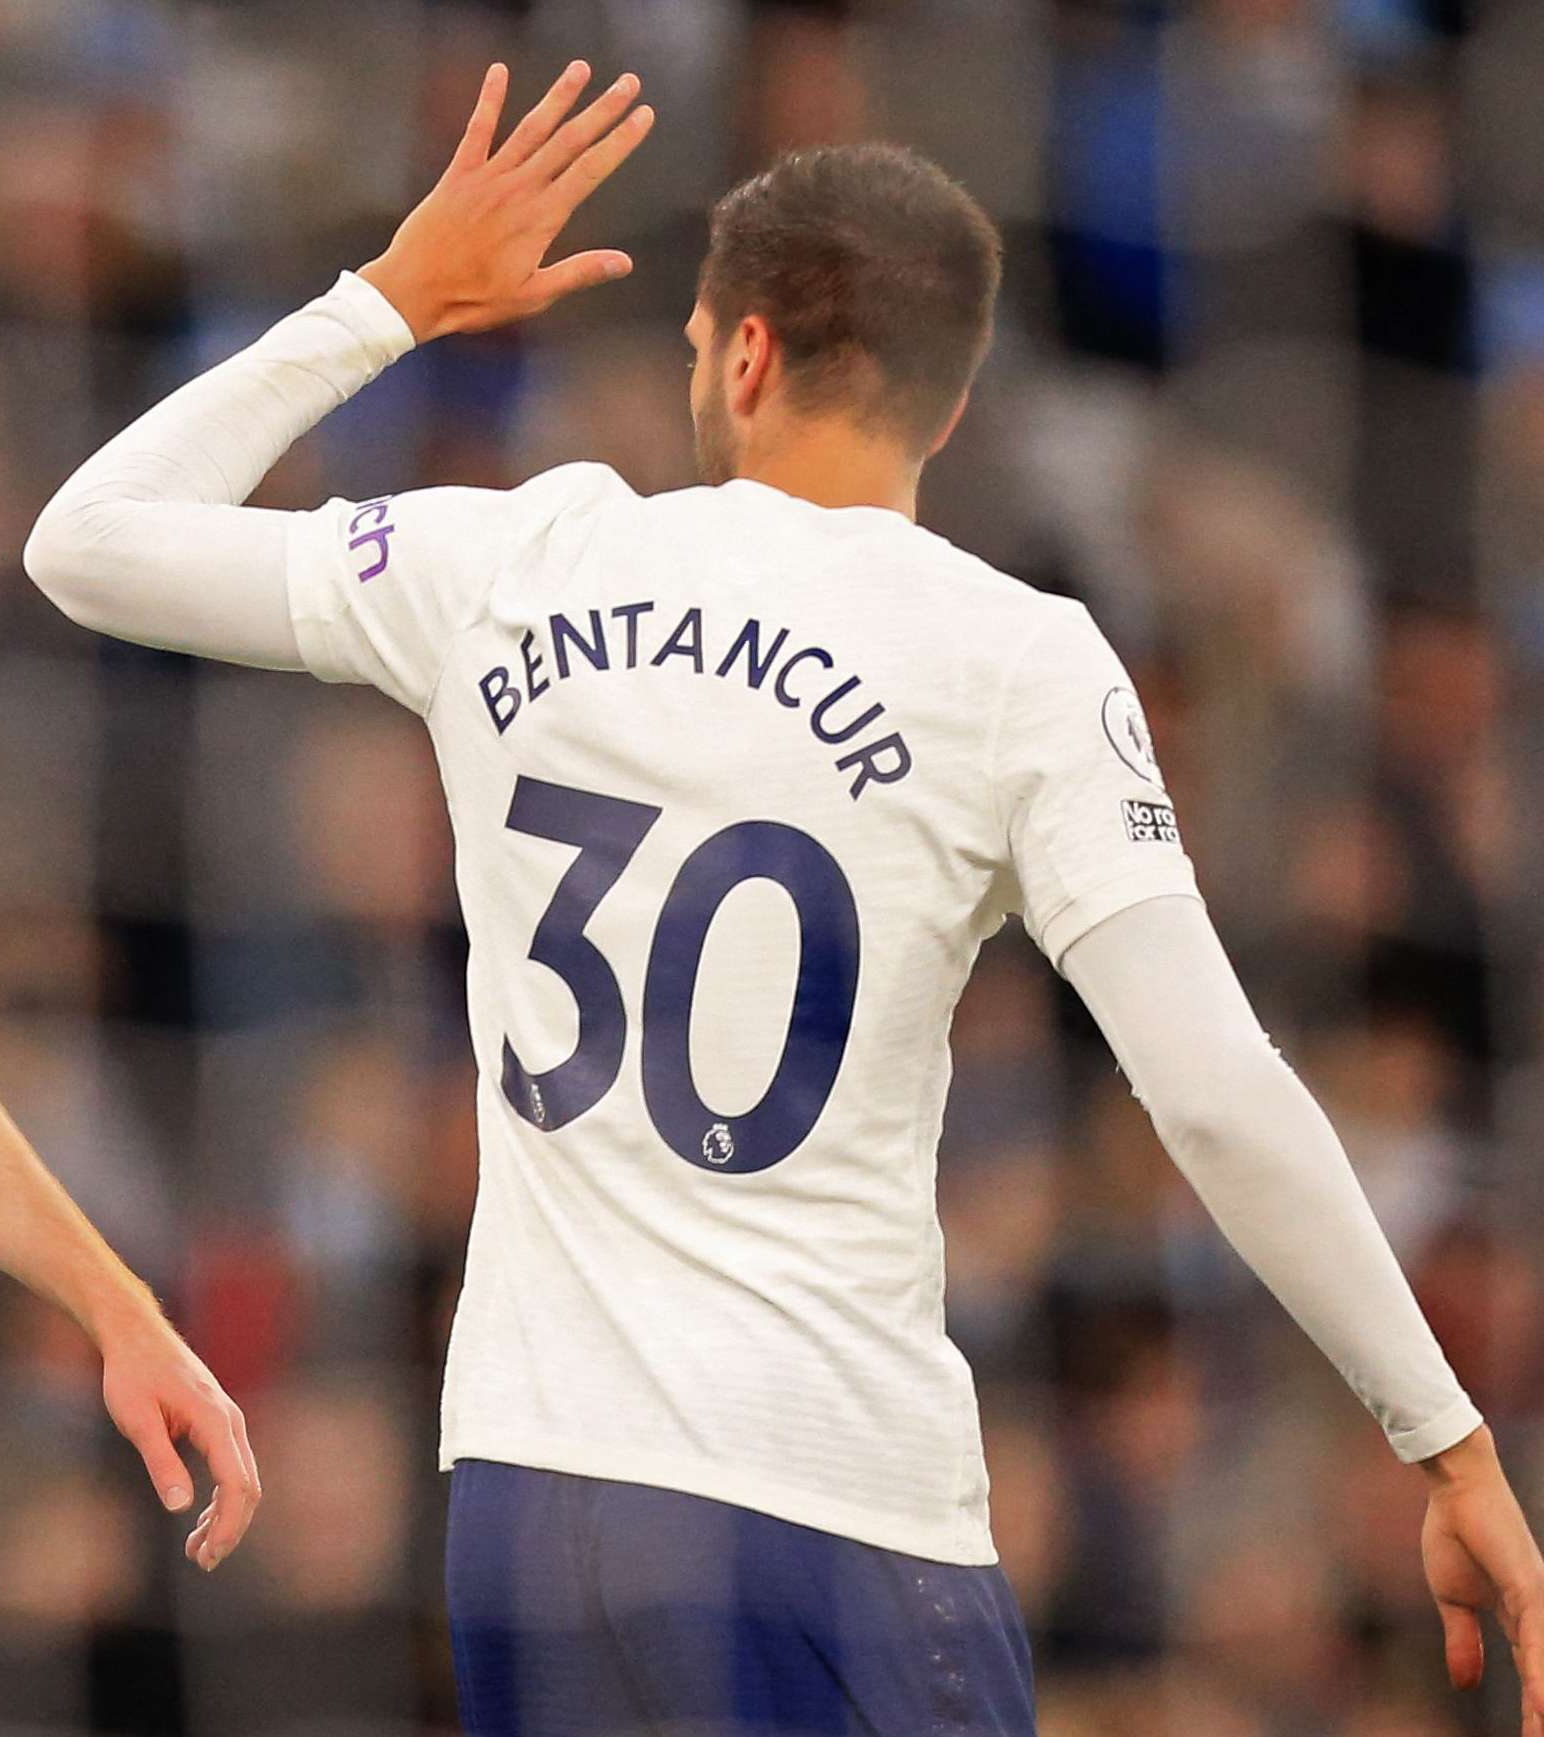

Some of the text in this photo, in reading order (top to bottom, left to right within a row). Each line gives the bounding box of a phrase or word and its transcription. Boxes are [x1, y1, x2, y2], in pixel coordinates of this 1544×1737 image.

[477, 600, 913, 802] BENTANCUR
[1124, 801, 1153, 826] No
[500, 773, 861, 1175] 30
